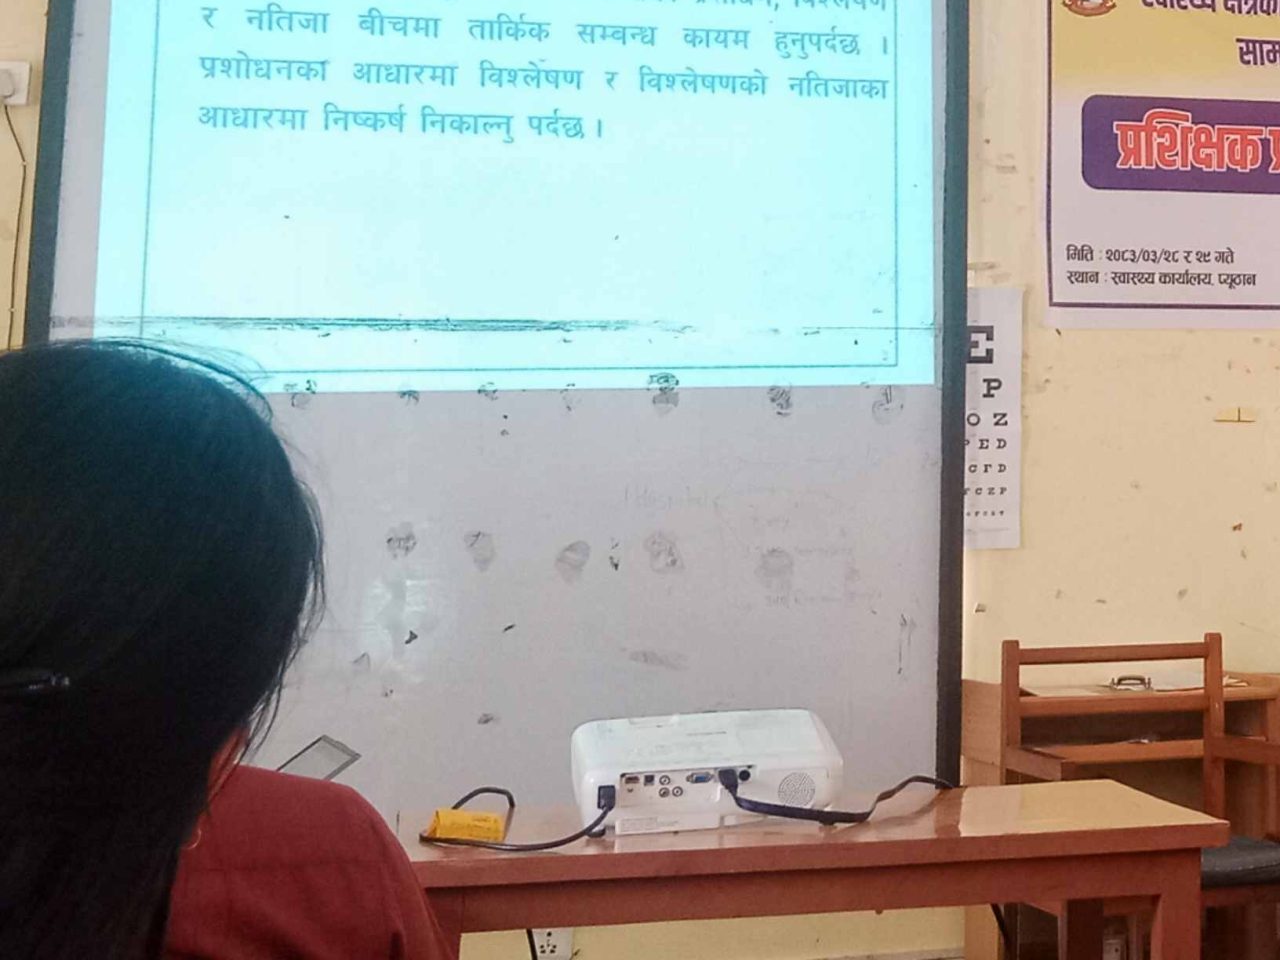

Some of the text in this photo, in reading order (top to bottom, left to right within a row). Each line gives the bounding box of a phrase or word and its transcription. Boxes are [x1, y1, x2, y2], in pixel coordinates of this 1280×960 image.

[201, 5, 217, 28] र
[246, 3, 329, 33] नतिजा
[358, 8, 440, 38] बीचमा
[468, 11, 551, 42] तार्किक
[683, 28, 749, 50] कायम
[774, 26, 859, 59] हुनुपर्दछ
[199, 51, 887, 99] प्रशोधनका आधारमा विश्लेषण र विश्लेषणको नतिजाका
[199, 105, 308, 131] आधारमा
[323, 102, 406, 133] निष्कर्ष
[421, 107, 515, 144] निकाल्नु
[529, 109, 584, 139] पर्दछ
[1113, 107, 1266, 173] प्रशिक्षक
[1183, 250, 1192, 264] र
[1214, 247, 1235, 264] गते
[1067, 270, 1099, 285] स्थान
[1111, 271, 1156, 286] स्वास्थ्य
[1218, 273, 1256, 289] प्यूठान
[982, 378, 1002, 398] P
